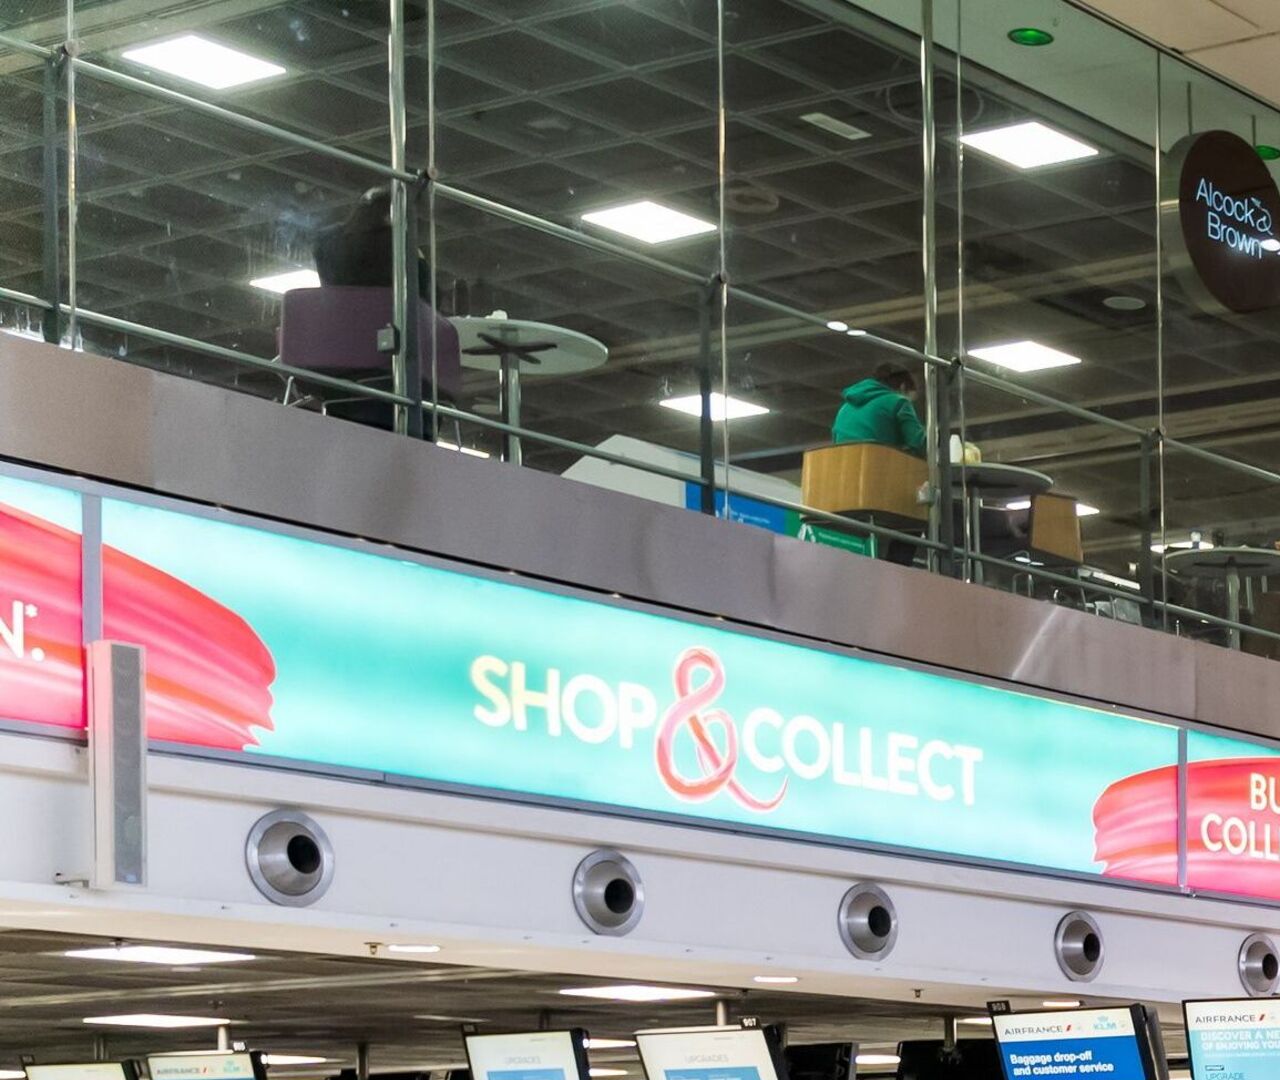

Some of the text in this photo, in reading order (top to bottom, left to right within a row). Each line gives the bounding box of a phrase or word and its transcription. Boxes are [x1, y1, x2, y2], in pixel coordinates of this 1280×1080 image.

[1196, 178, 1255, 227] Alcock
[1207, 211, 1264, 260] Brown
[469, 646, 984, 813] SHOP & COLLECT
[1195, 1014, 1255, 1023] AIRFRANCE
[1004, 1025, 1063, 1036] AIRFRANCE
[1200, 1031, 1251, 1041] DISCOVER
[1254, 1031, 1264, 1040] A
[1202, 1041, 1214, 1050] OF
[1215, 1040, 1260, 1050] ENJOYING
[1009, 1050, 1092, 1066] Baggage drop-off
[1013, 1062, 1115, 1076] and customer service
[1205, 1072, 1246, 1080] UPGRADE
